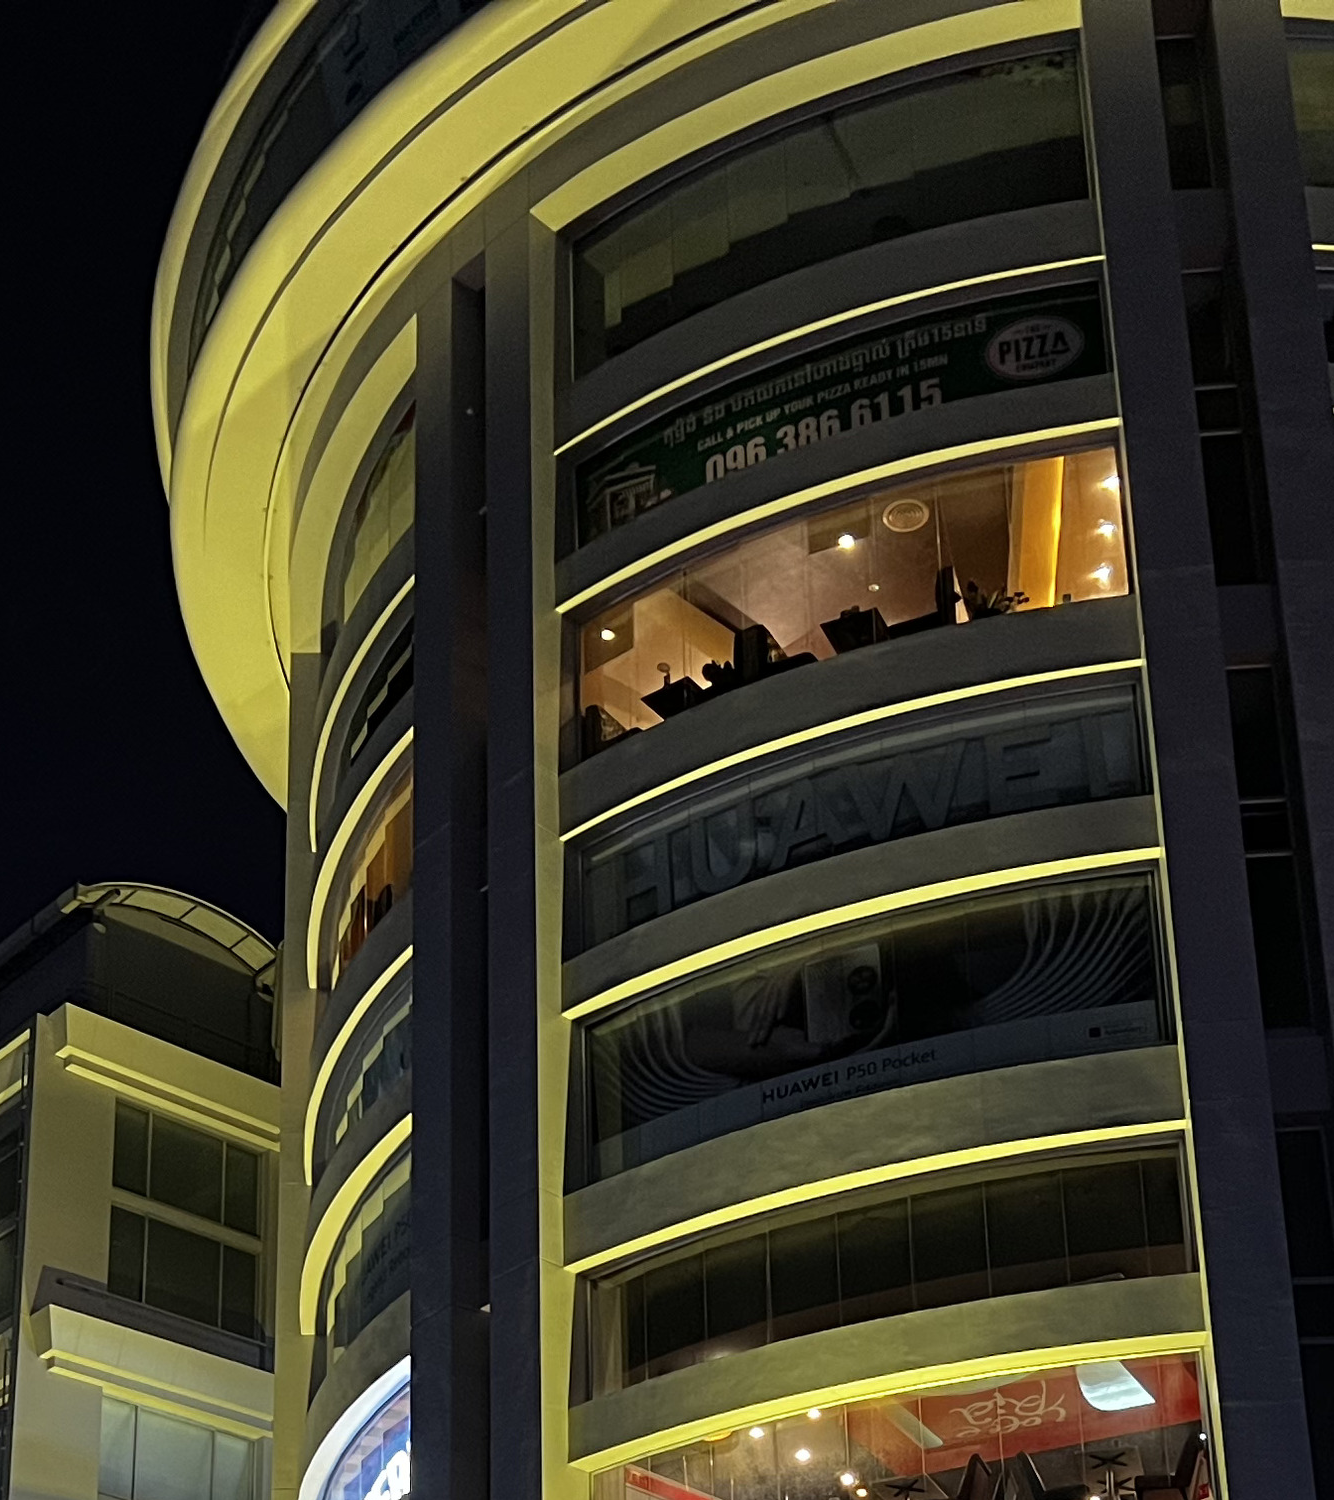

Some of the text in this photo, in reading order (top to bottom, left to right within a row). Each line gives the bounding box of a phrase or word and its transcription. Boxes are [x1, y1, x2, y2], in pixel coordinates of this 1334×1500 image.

[998, 331, 1070, 365] PIZZA
[697, 431, 725, 453] CALL
[736, 413, 765, 436] PICK
[766, 405, 782, 424] UP
[783, 394, 815, 416] YOUR
[816, 381, 852, 405] PIZZA
[853, 371, 895, 392] READY
[706, 376, 945, 485] 096 386 6115
[617, 720, 1112, 924] HUAWEI
[762, 1070, 839, 1104] HUAWEI
[846, 1061, 878, 1081] P50
[882, 1049, 936, 1072] Pocket
